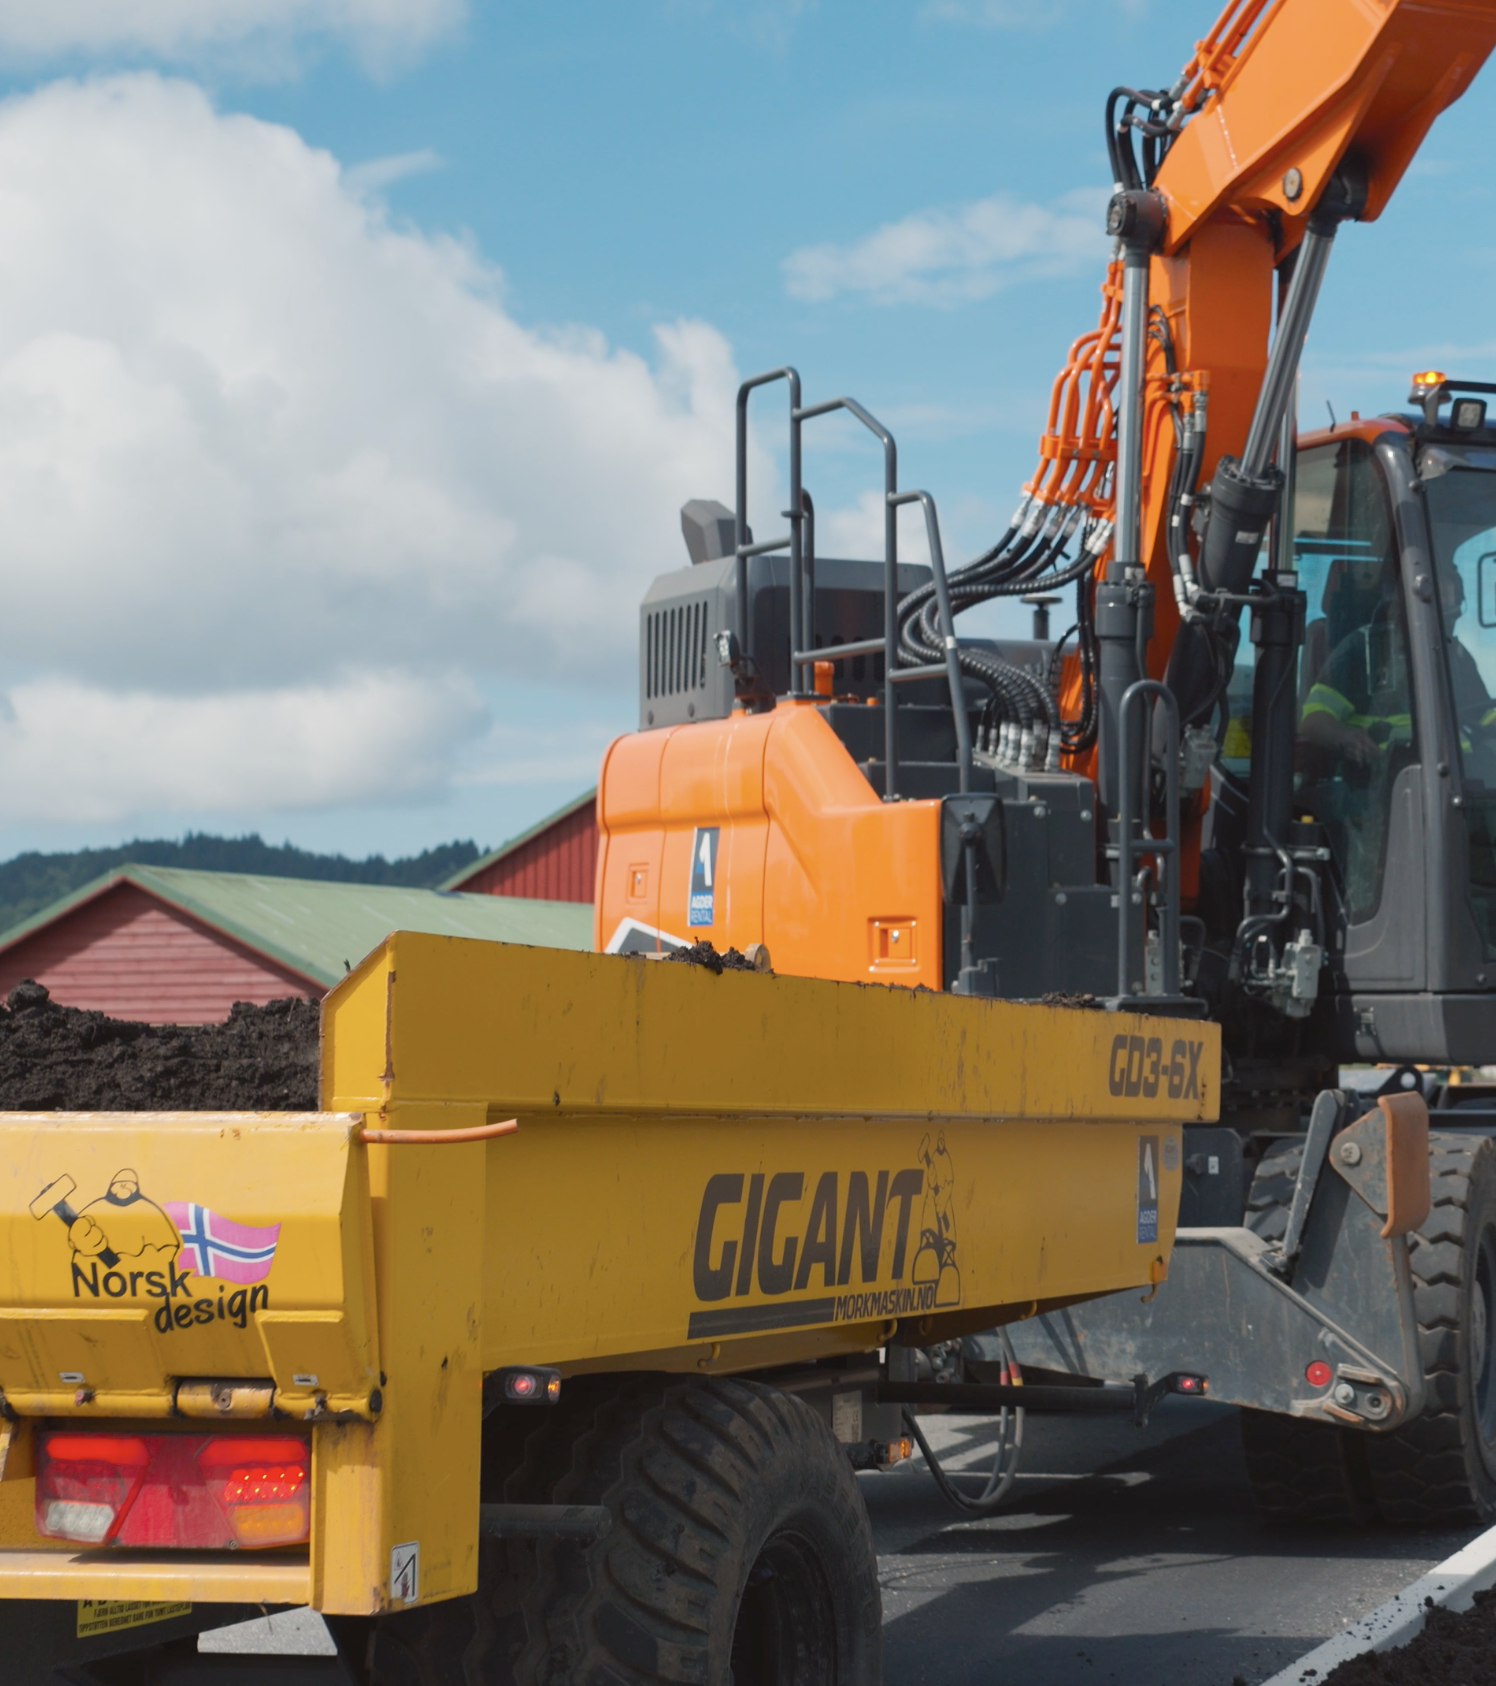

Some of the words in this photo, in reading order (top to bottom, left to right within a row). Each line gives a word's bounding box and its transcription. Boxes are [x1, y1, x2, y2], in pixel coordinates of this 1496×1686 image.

[691, 895, 713, 909] AGDER
[1108, 1034, 1204, 1099] GD3-6X
[693, 1169, 924, 1302] GIGANT
[71, 1261, 193, 1297] Norsk
[154, 1284, 269, 1333] design
[834, 1284, 934, 1321] MORKMASKIN.NO
